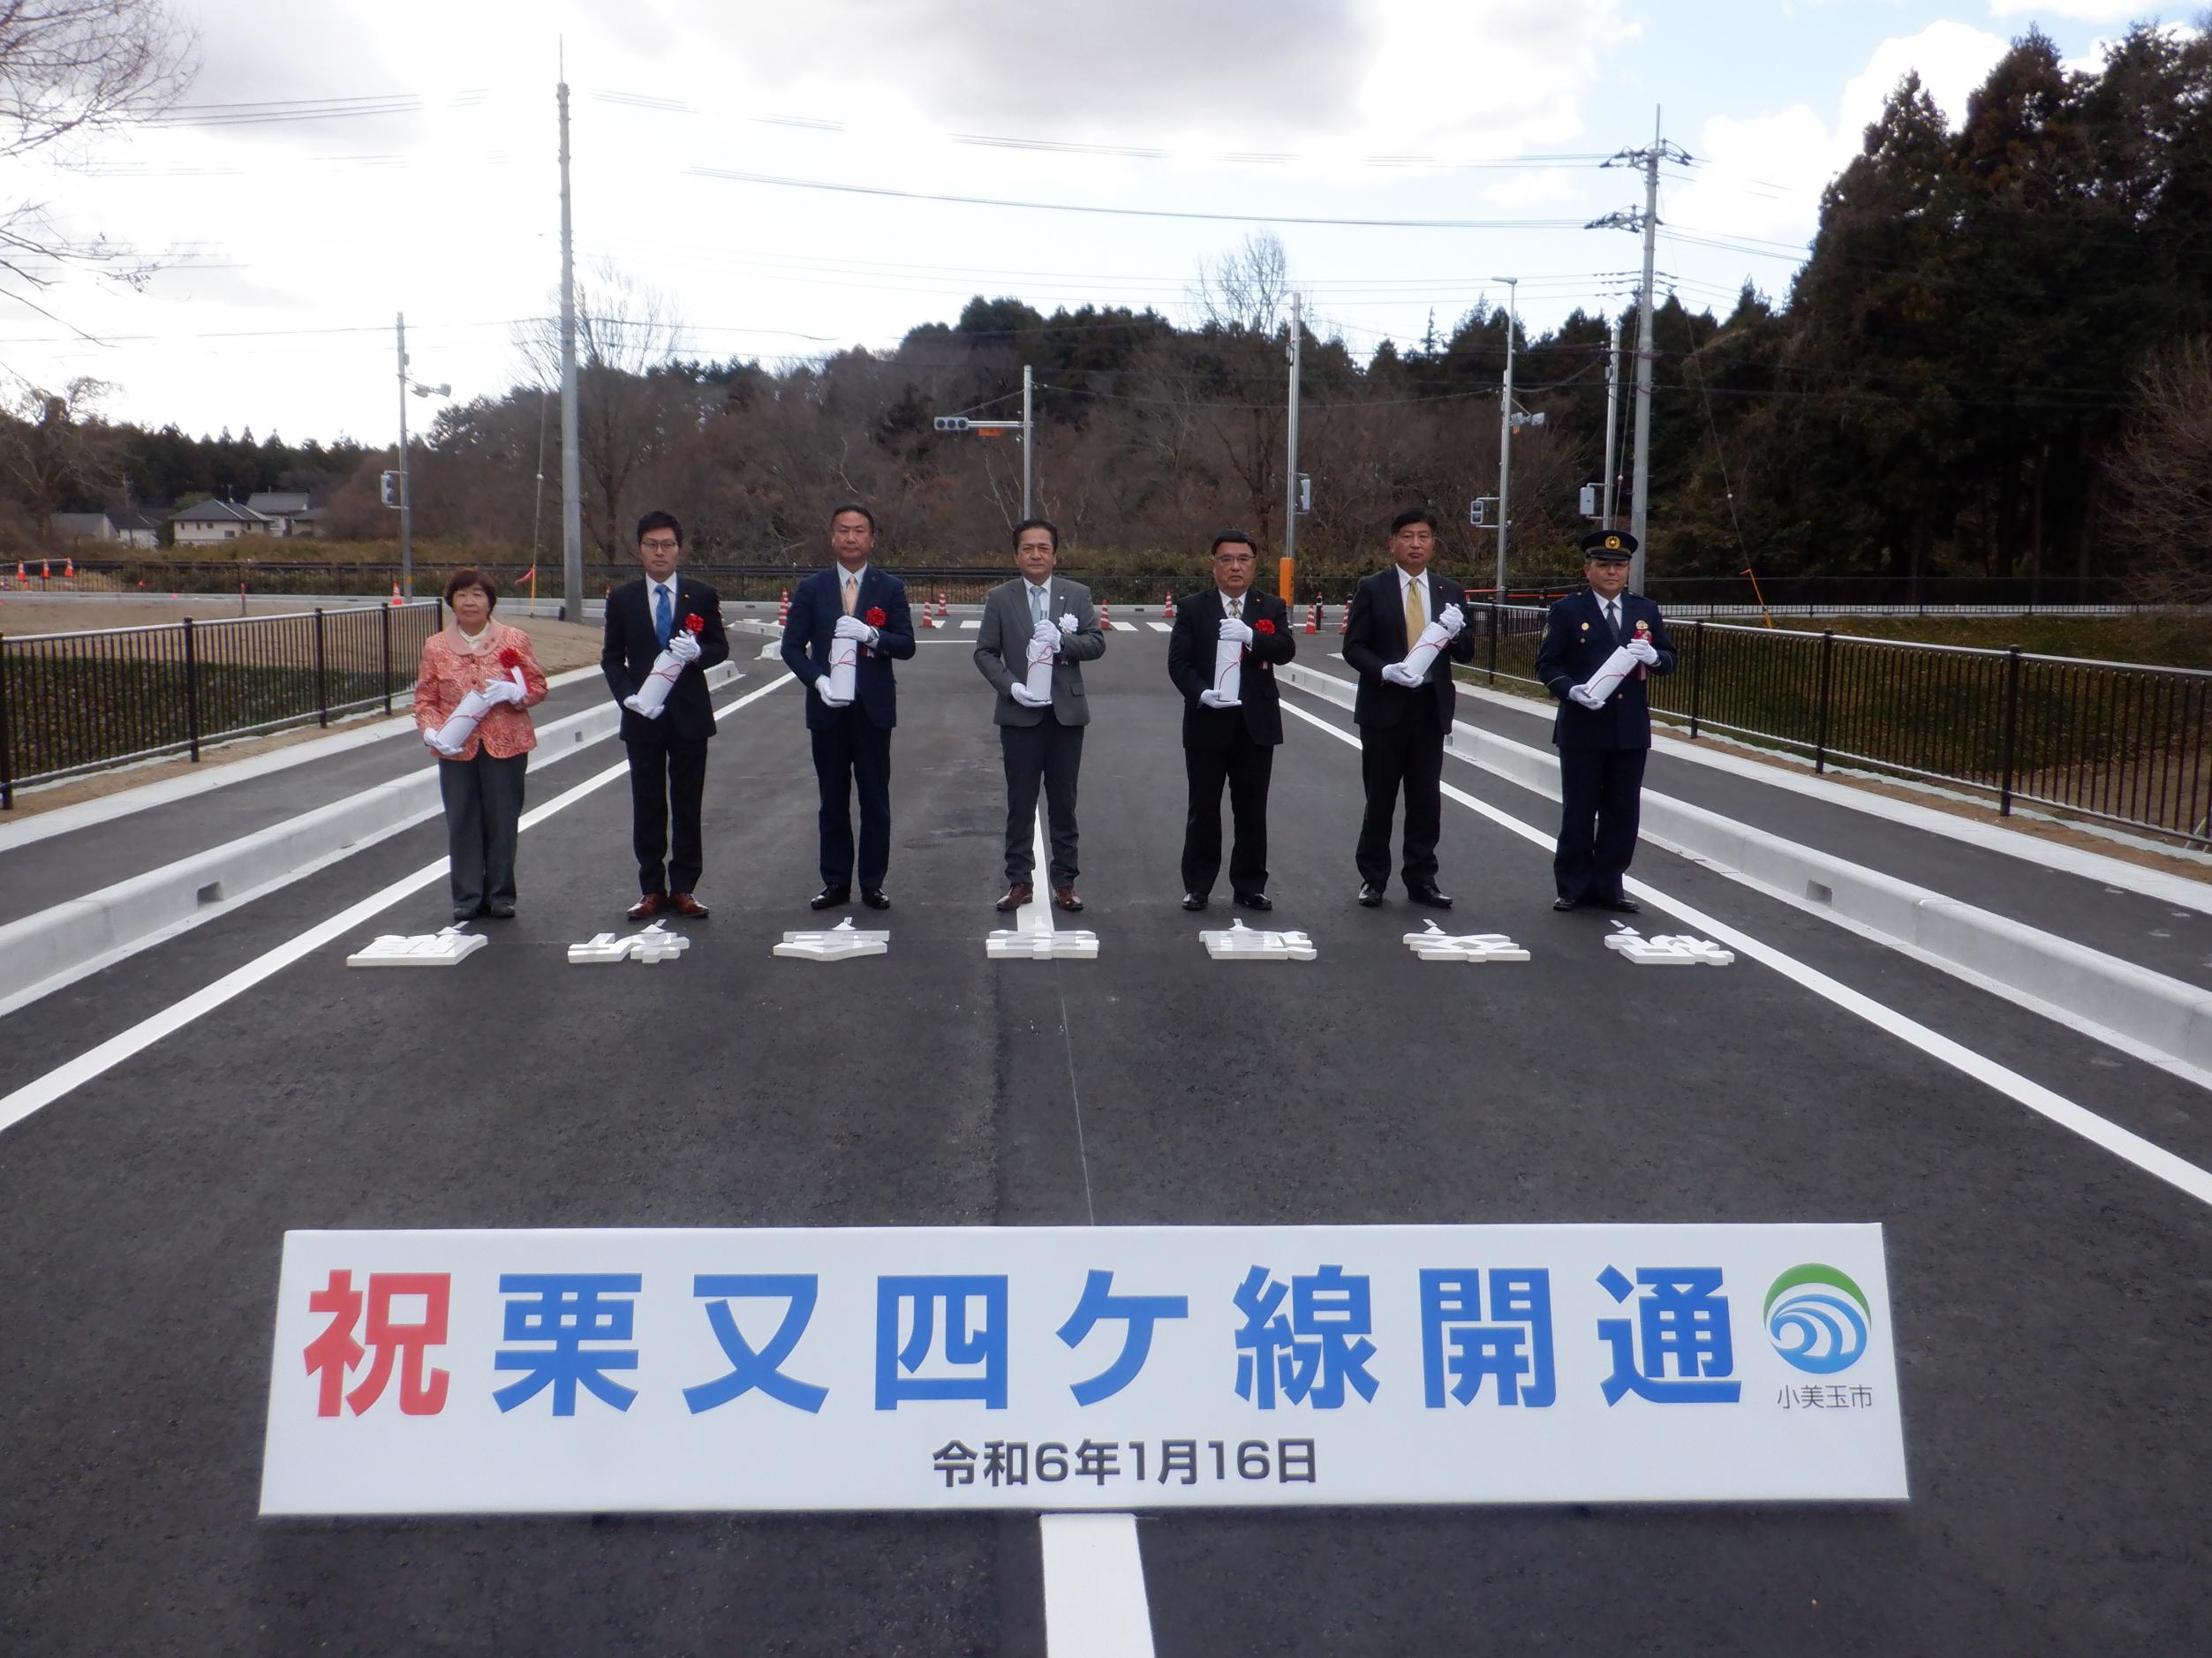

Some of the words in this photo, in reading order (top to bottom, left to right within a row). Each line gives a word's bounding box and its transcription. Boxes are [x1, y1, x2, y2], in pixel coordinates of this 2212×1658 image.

[1777, 1384, 1873, 1410] 小美玉市
[932, 1438, 1316, 1488] 令和6年1月16日
